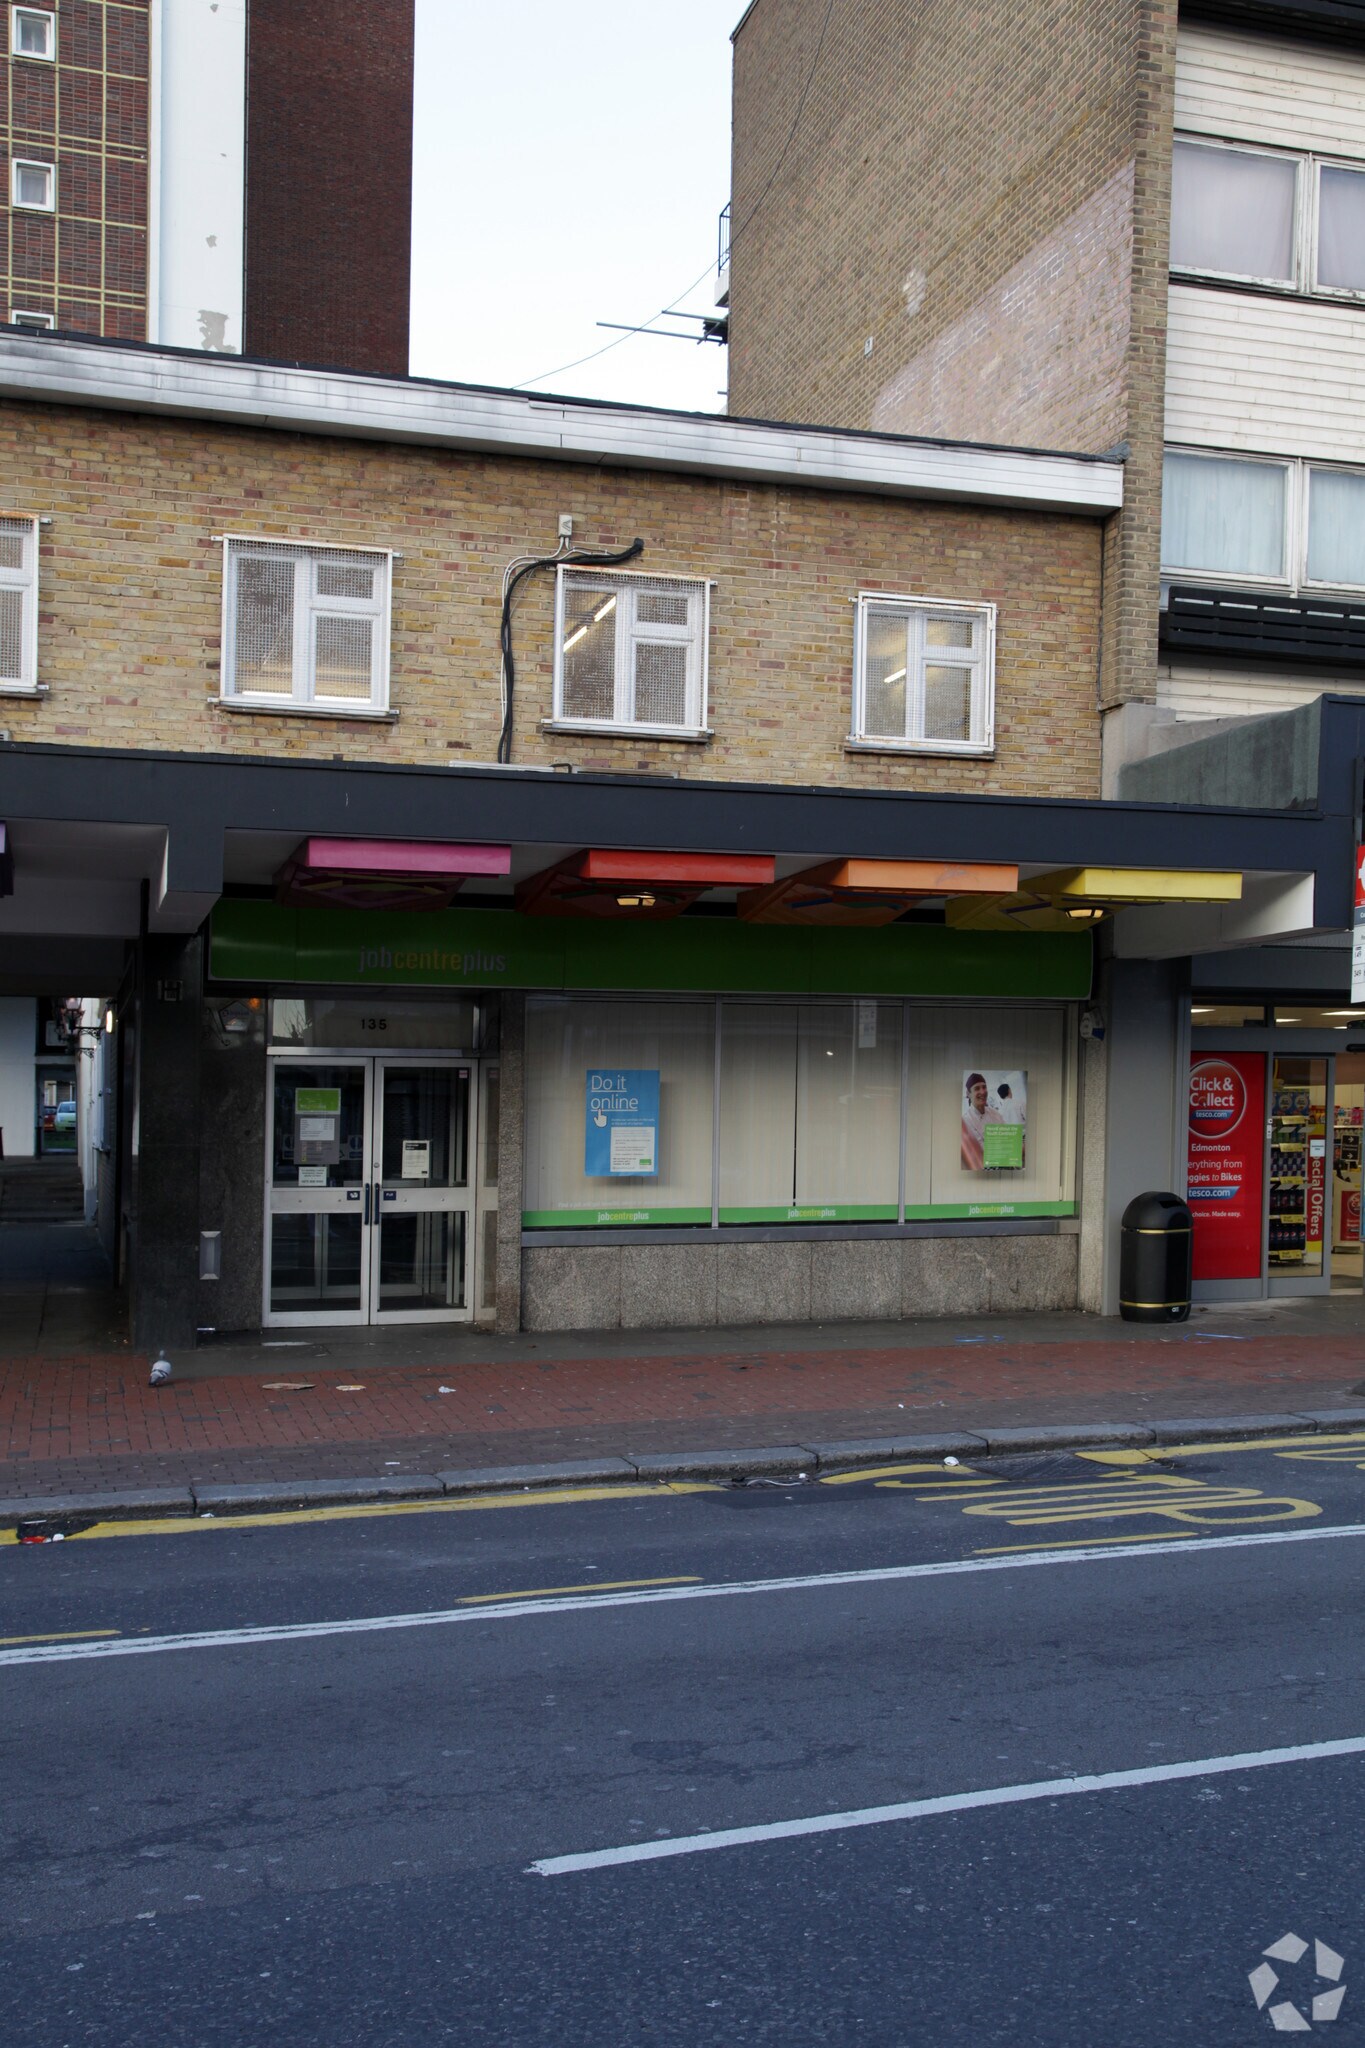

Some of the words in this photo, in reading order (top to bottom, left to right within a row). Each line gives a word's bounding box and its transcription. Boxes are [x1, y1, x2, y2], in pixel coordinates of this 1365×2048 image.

[358, 945, 507, 976] jobcentreplus
[361, 1018, 387, 1030] 135
[591, 1075, 613, 1091] Do
[617, 1074, 627, 1090] it
[1190, 1077, 1222, 1091] Click
[1222, 1077, 1234, 1091] &
[591, 1094, 639, 1110] online
[1195, 1111, 1228, 1119] tesco.com
[1191, 1144, 1231, 1152] Edmonton
[1188, 1160, 1221, 1171] erything
[1223, 1159, 1243, 1169] from
[1188, 1173, 1210, 1184] ggies
[1212, 1174, 1220, 1182] to
[1221, 1172, 1242, 1181] Bikes
[1311, 1156, 1324, 1191] ecial
[1188, 1189, 1231, 1198] tesco.com
[788, 1208, 836, 1219] jobcentreplus
[968, 1205, 1015, 1216] jobcentreplus
[1310, 1193, 1324, 1236] Offers
[598, 1211, 649, 1223] jobcentreplus
